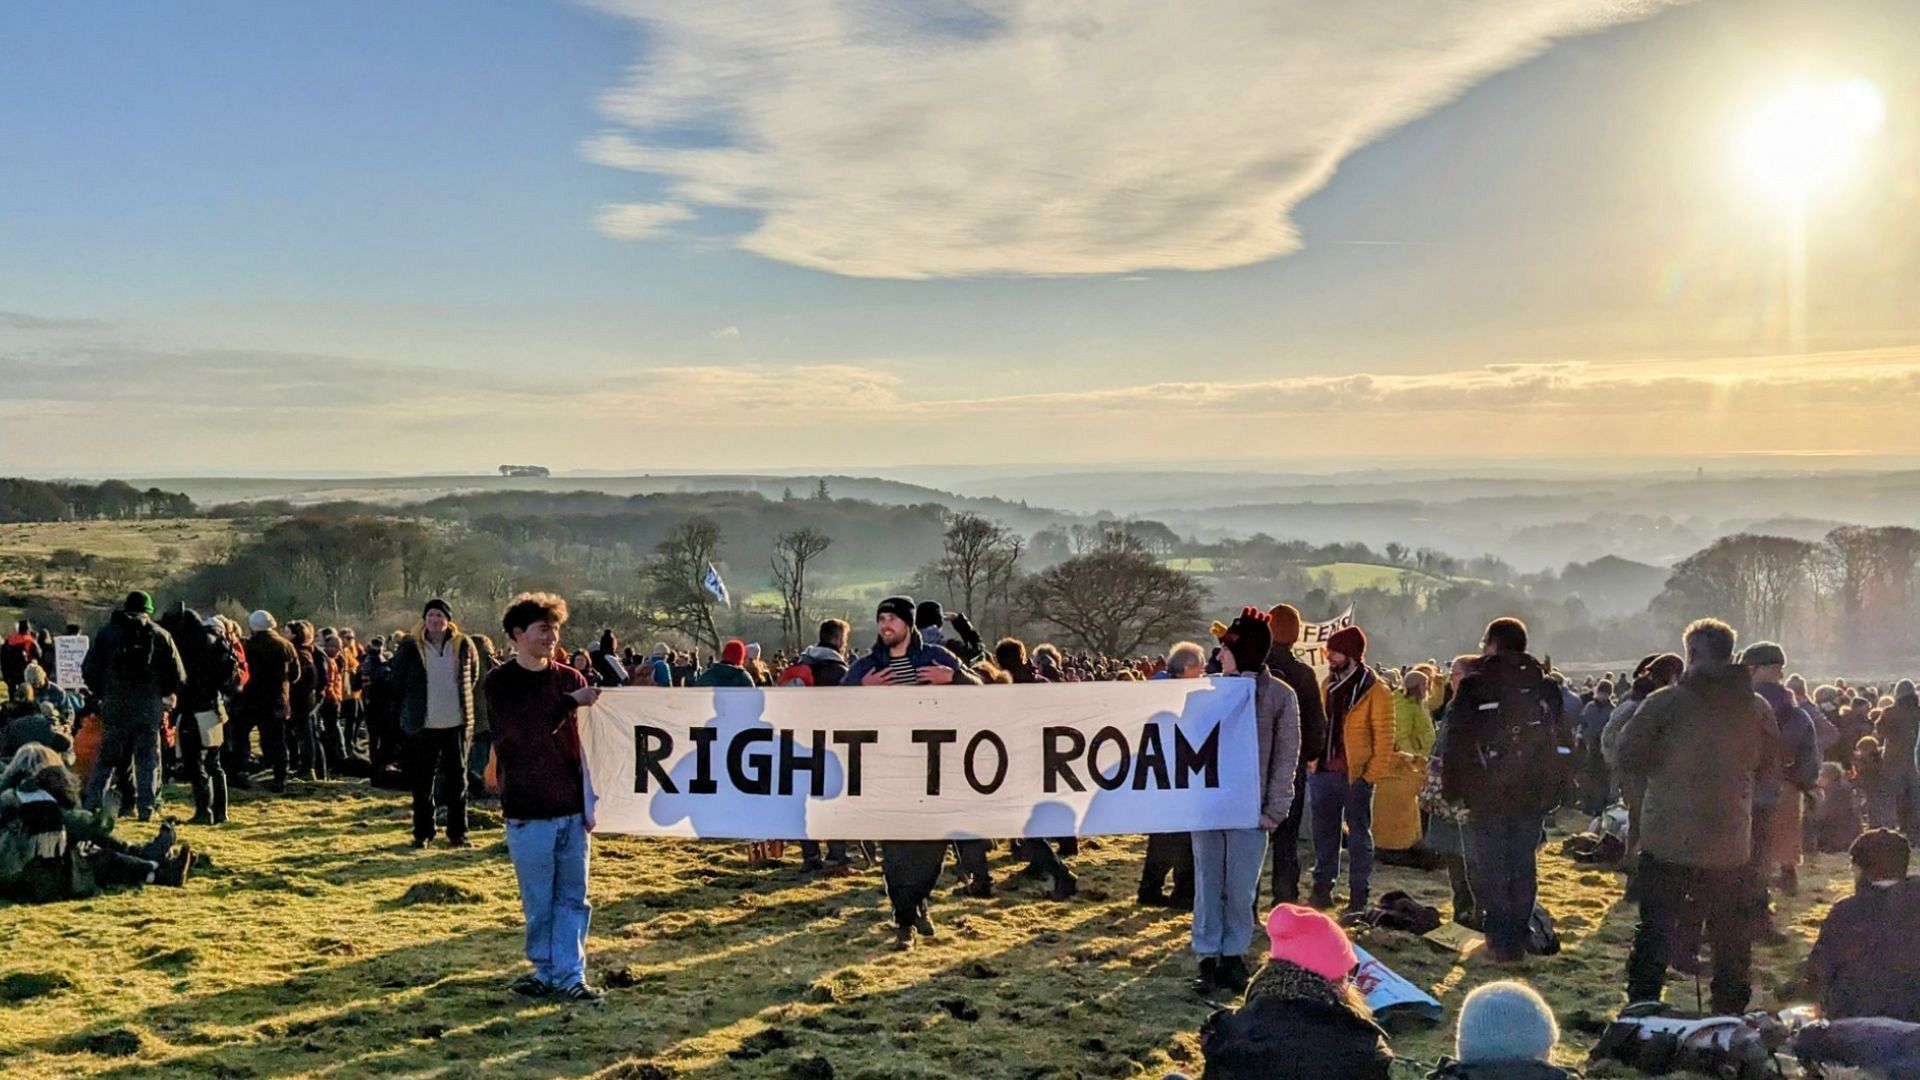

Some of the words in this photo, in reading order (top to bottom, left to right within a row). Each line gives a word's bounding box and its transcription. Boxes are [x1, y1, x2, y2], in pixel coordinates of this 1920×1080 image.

[635, 726, 877, 796] RIGHT
[912, 730, 1008, 795] TO
[1044, 721, 1220, 792] ROAM
